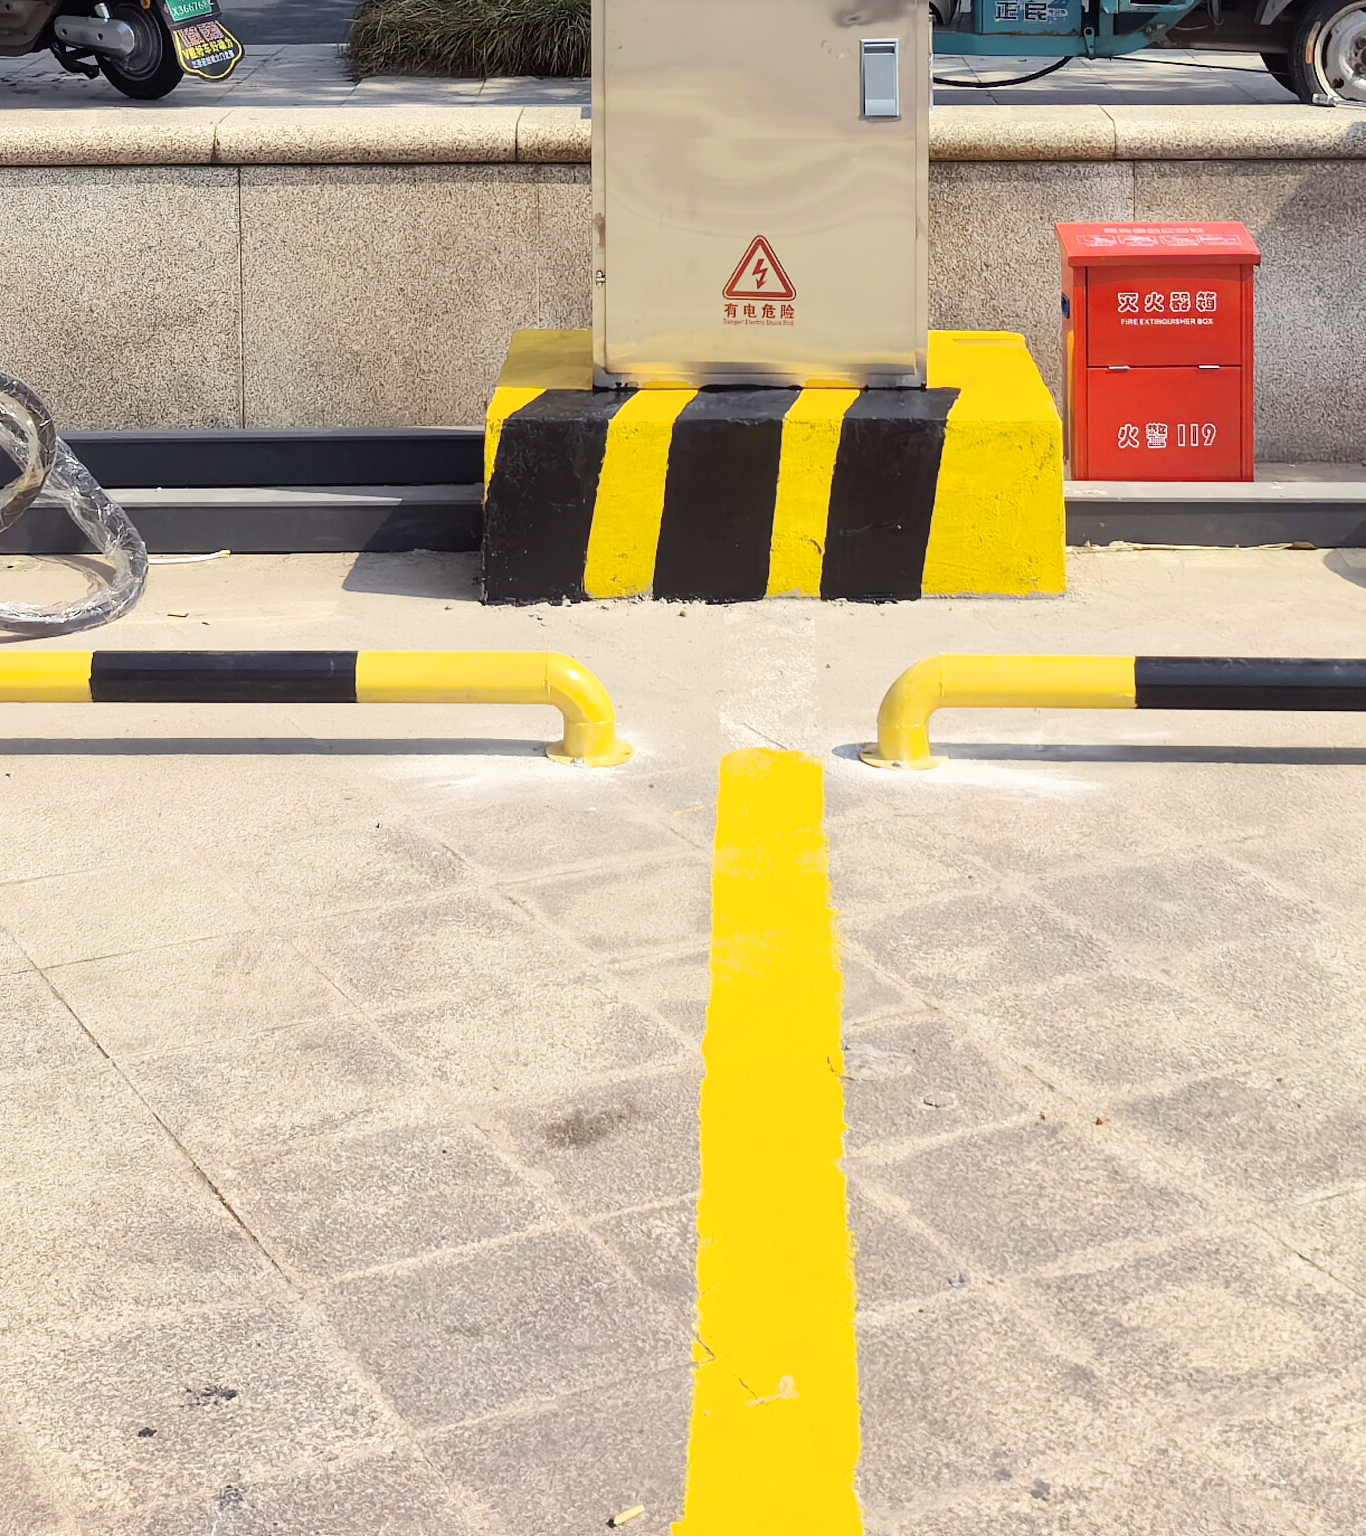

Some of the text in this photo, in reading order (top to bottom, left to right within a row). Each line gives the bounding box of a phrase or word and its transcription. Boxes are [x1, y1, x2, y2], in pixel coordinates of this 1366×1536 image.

[994, 0, 1047, 22] 正民
[724, 303, 795, 319] 有电危险
[1117, 292, 1217, 313] 灭火器箱
[1121, 318, 1139, 326] FIRE
